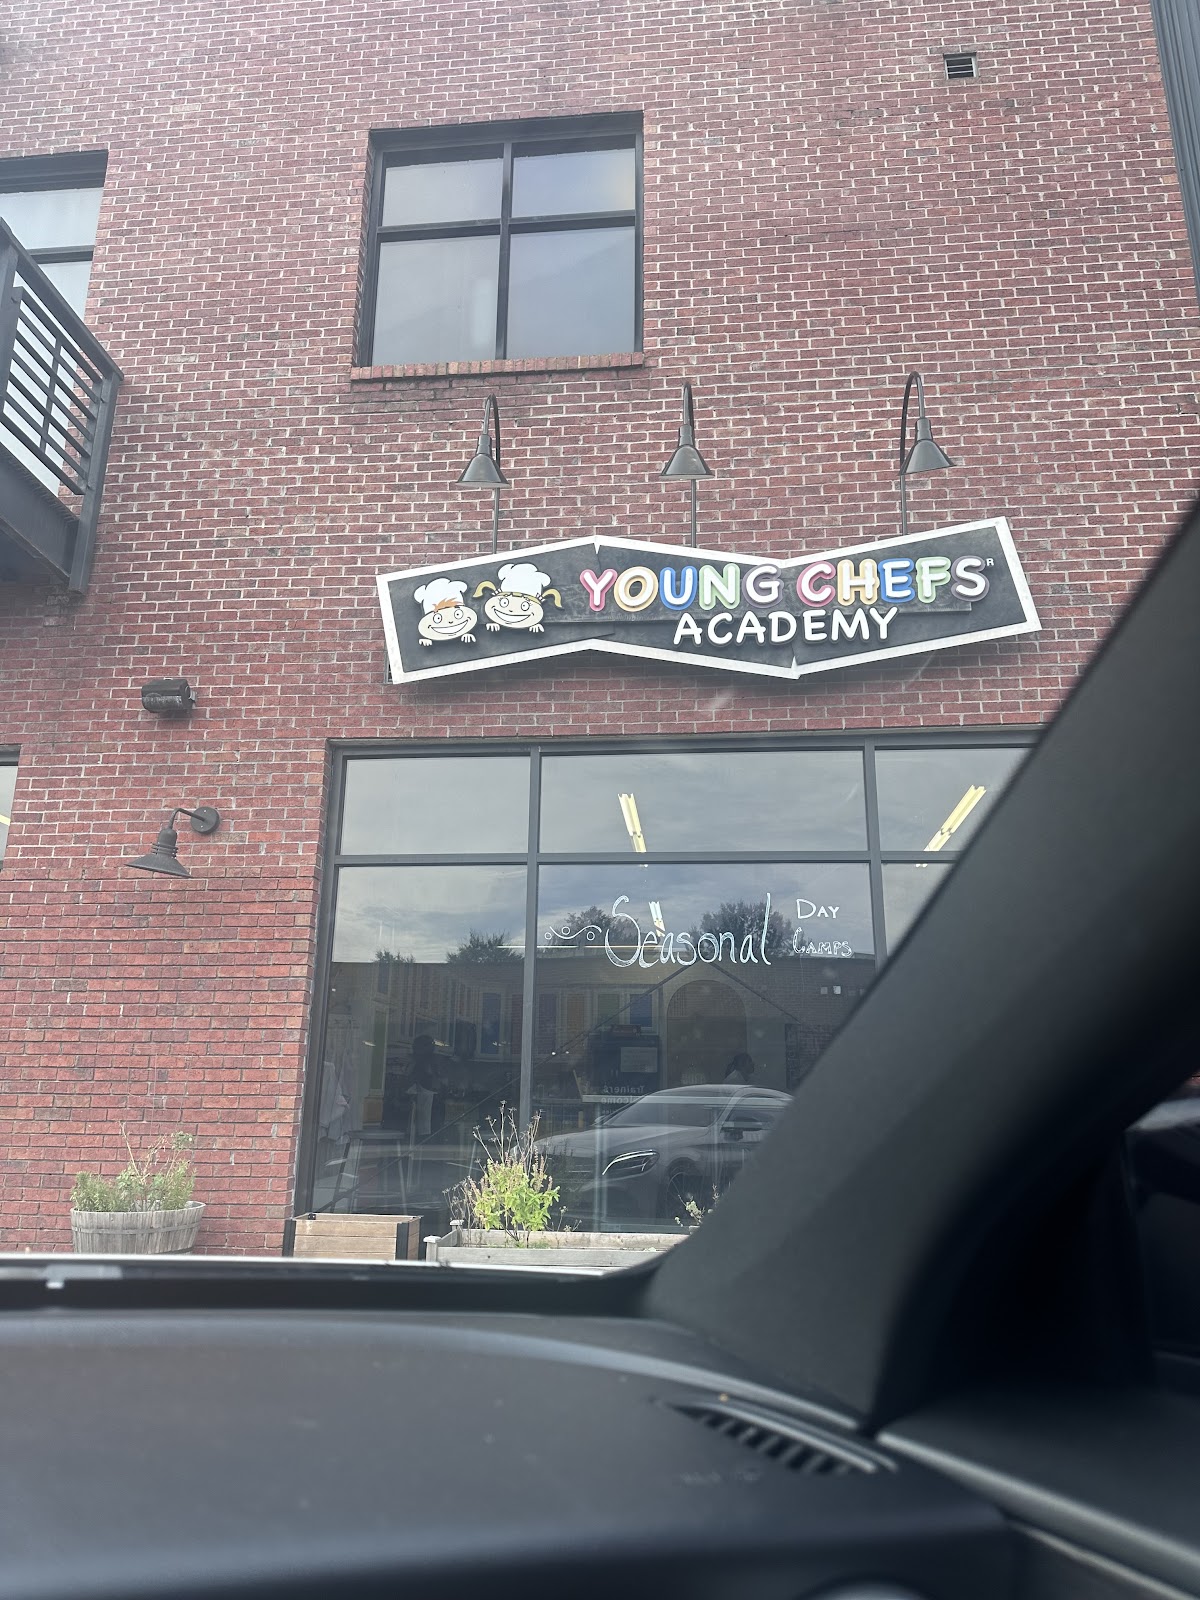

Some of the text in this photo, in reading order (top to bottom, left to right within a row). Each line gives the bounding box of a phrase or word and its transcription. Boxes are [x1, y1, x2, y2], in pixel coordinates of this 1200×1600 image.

[580, 563, 784, 612] YOUNG
[796, 555, 990, 607] CHEFS
[673, 606, 899, 646] ACADEMY
[604, 892, 772, 969] Seasonal
